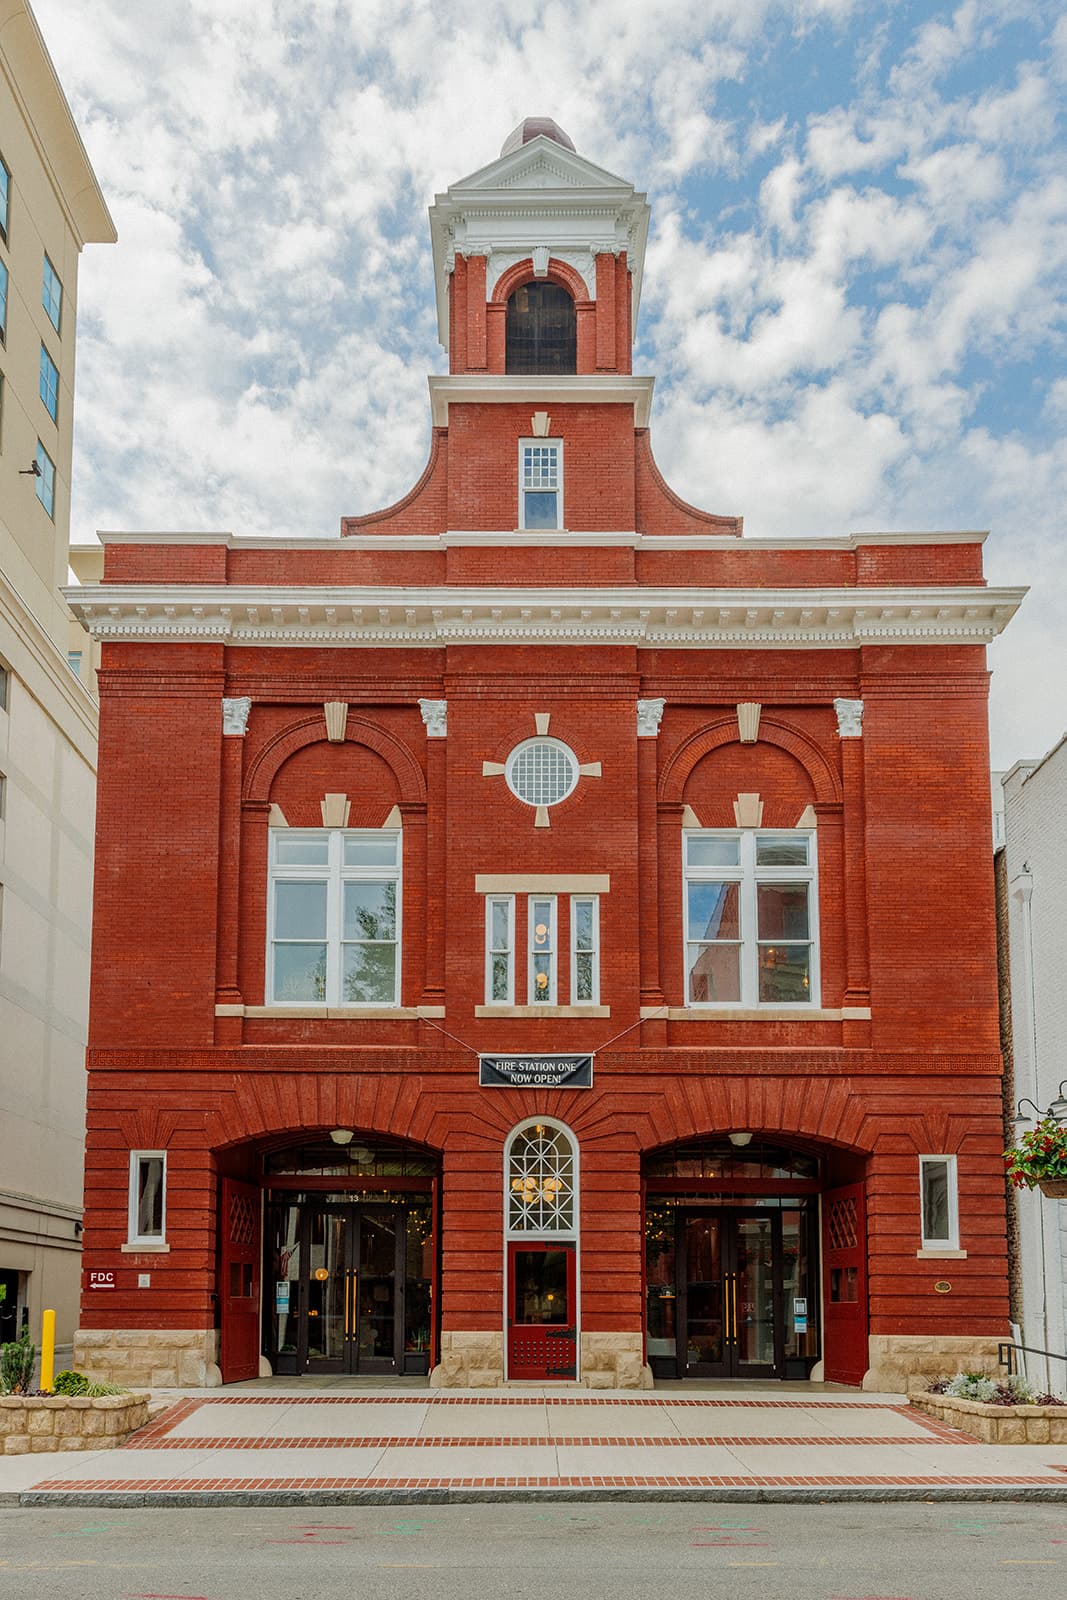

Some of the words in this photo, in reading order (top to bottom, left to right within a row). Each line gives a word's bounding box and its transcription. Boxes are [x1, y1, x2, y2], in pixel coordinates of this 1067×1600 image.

[496, 1061, 516, 1071] FIRE
[518, 1062, 555, 1072] STATION
[557, 1062, 577, 1072] ONE
[510, 1074, 532, 1083] NOW
[534, 1074, 561, 1084] OPEN!
[90, 1272, 114, 1282] FDC
